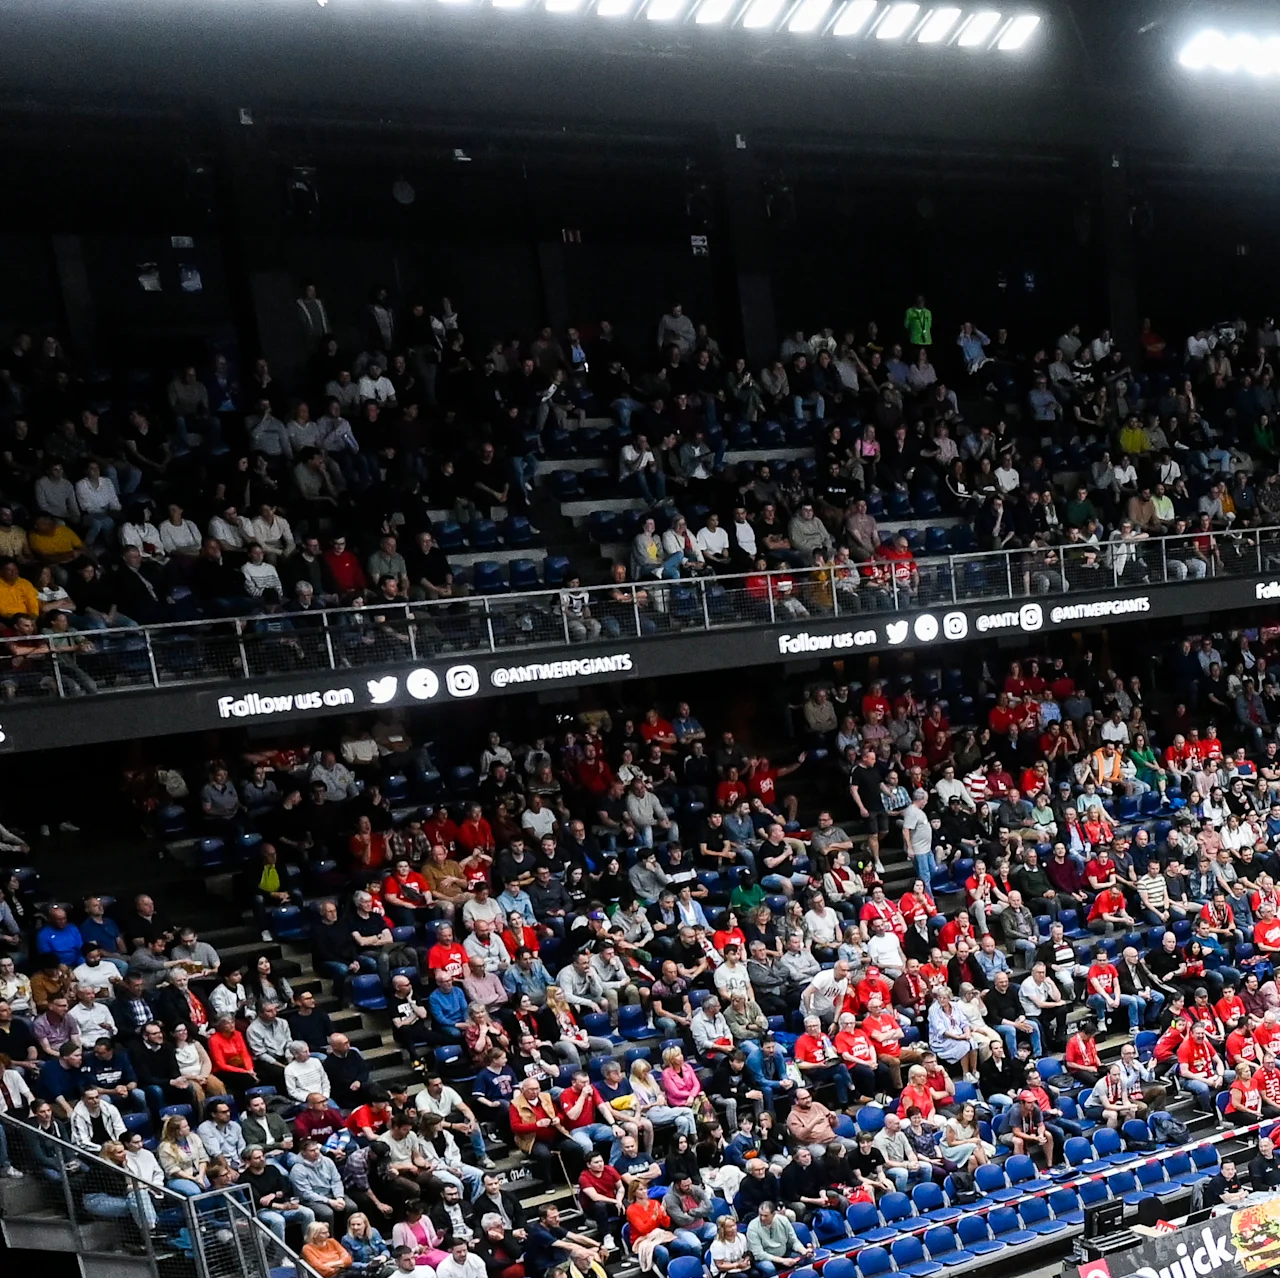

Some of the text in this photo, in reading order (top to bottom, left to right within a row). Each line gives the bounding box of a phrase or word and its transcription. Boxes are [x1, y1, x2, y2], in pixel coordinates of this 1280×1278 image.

[778, 596, 1150, 654] Follow us on @ANTWERPGIANTS
[219, 654, 632, 719] Follow us on @ANTWERPGIANTS
